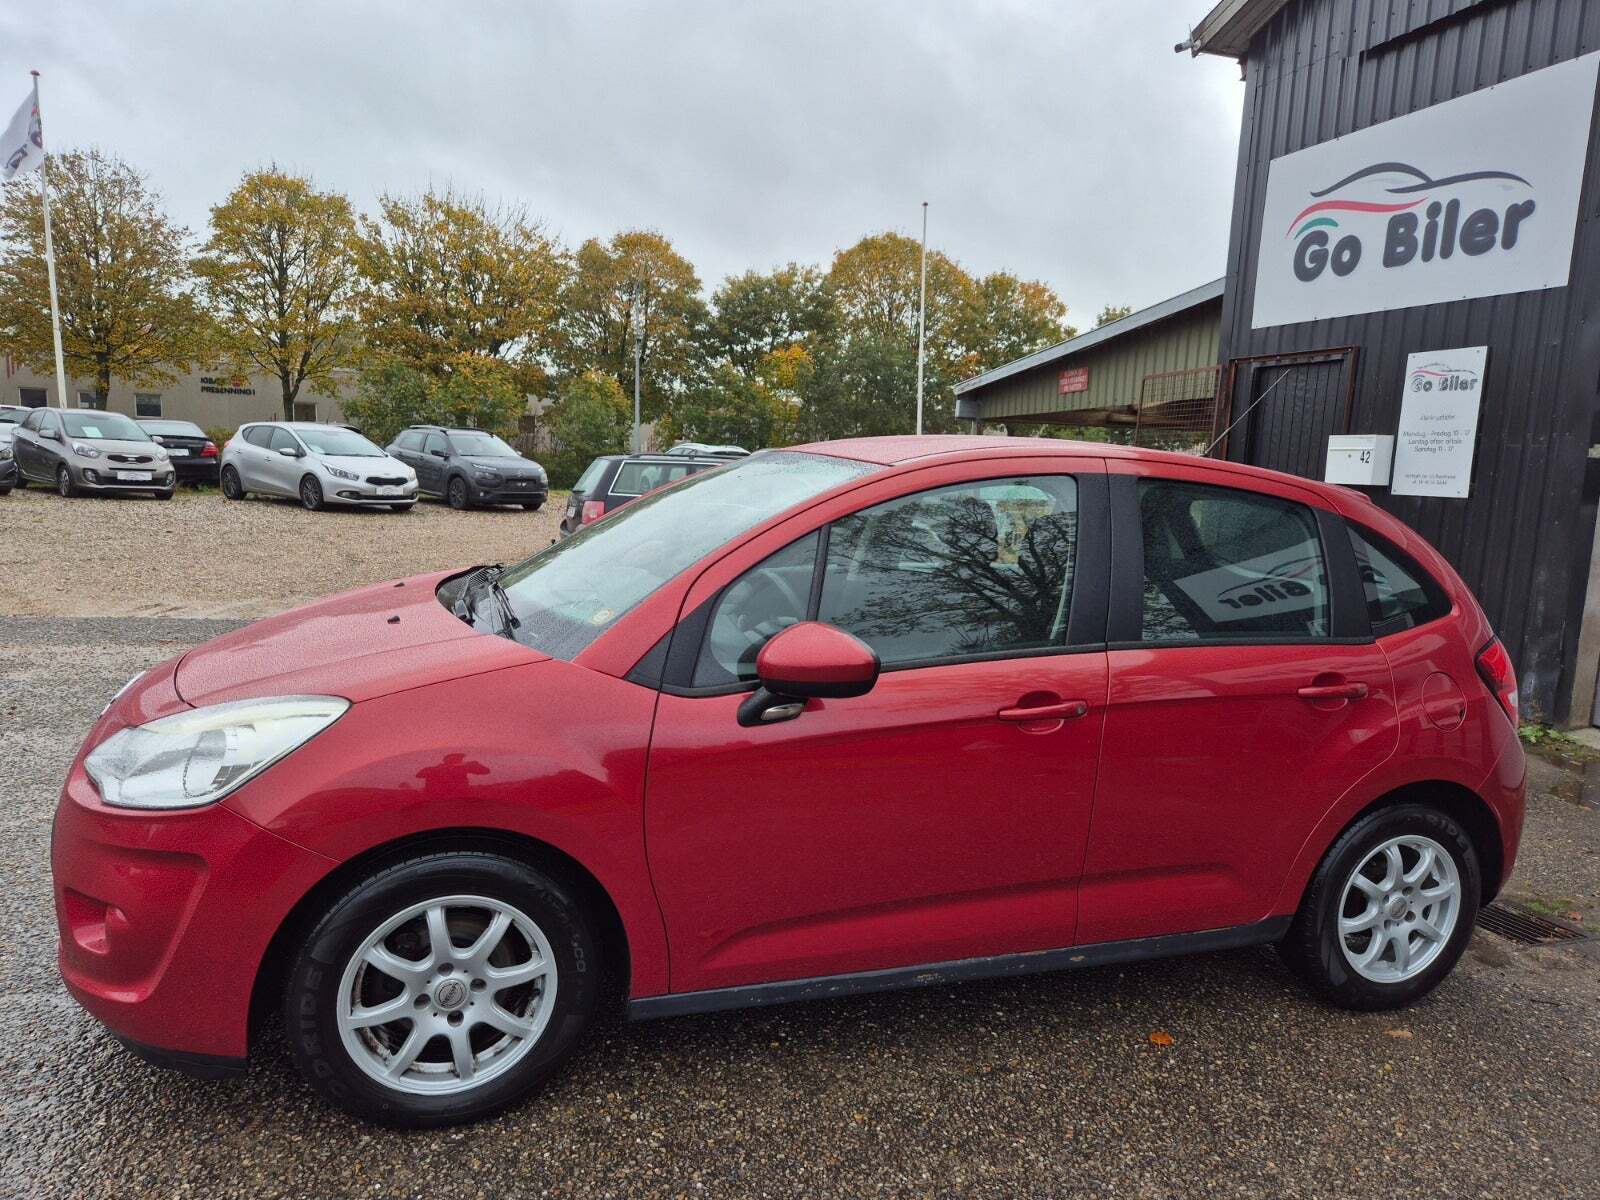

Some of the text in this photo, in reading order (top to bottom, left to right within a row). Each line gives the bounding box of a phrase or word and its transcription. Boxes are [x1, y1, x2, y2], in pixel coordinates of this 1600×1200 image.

[1293, 198, 1536, 282] Go Biler
[1411, 375, 1478, 392] Go Biler
[1360, 450, 1371, 464] 42
